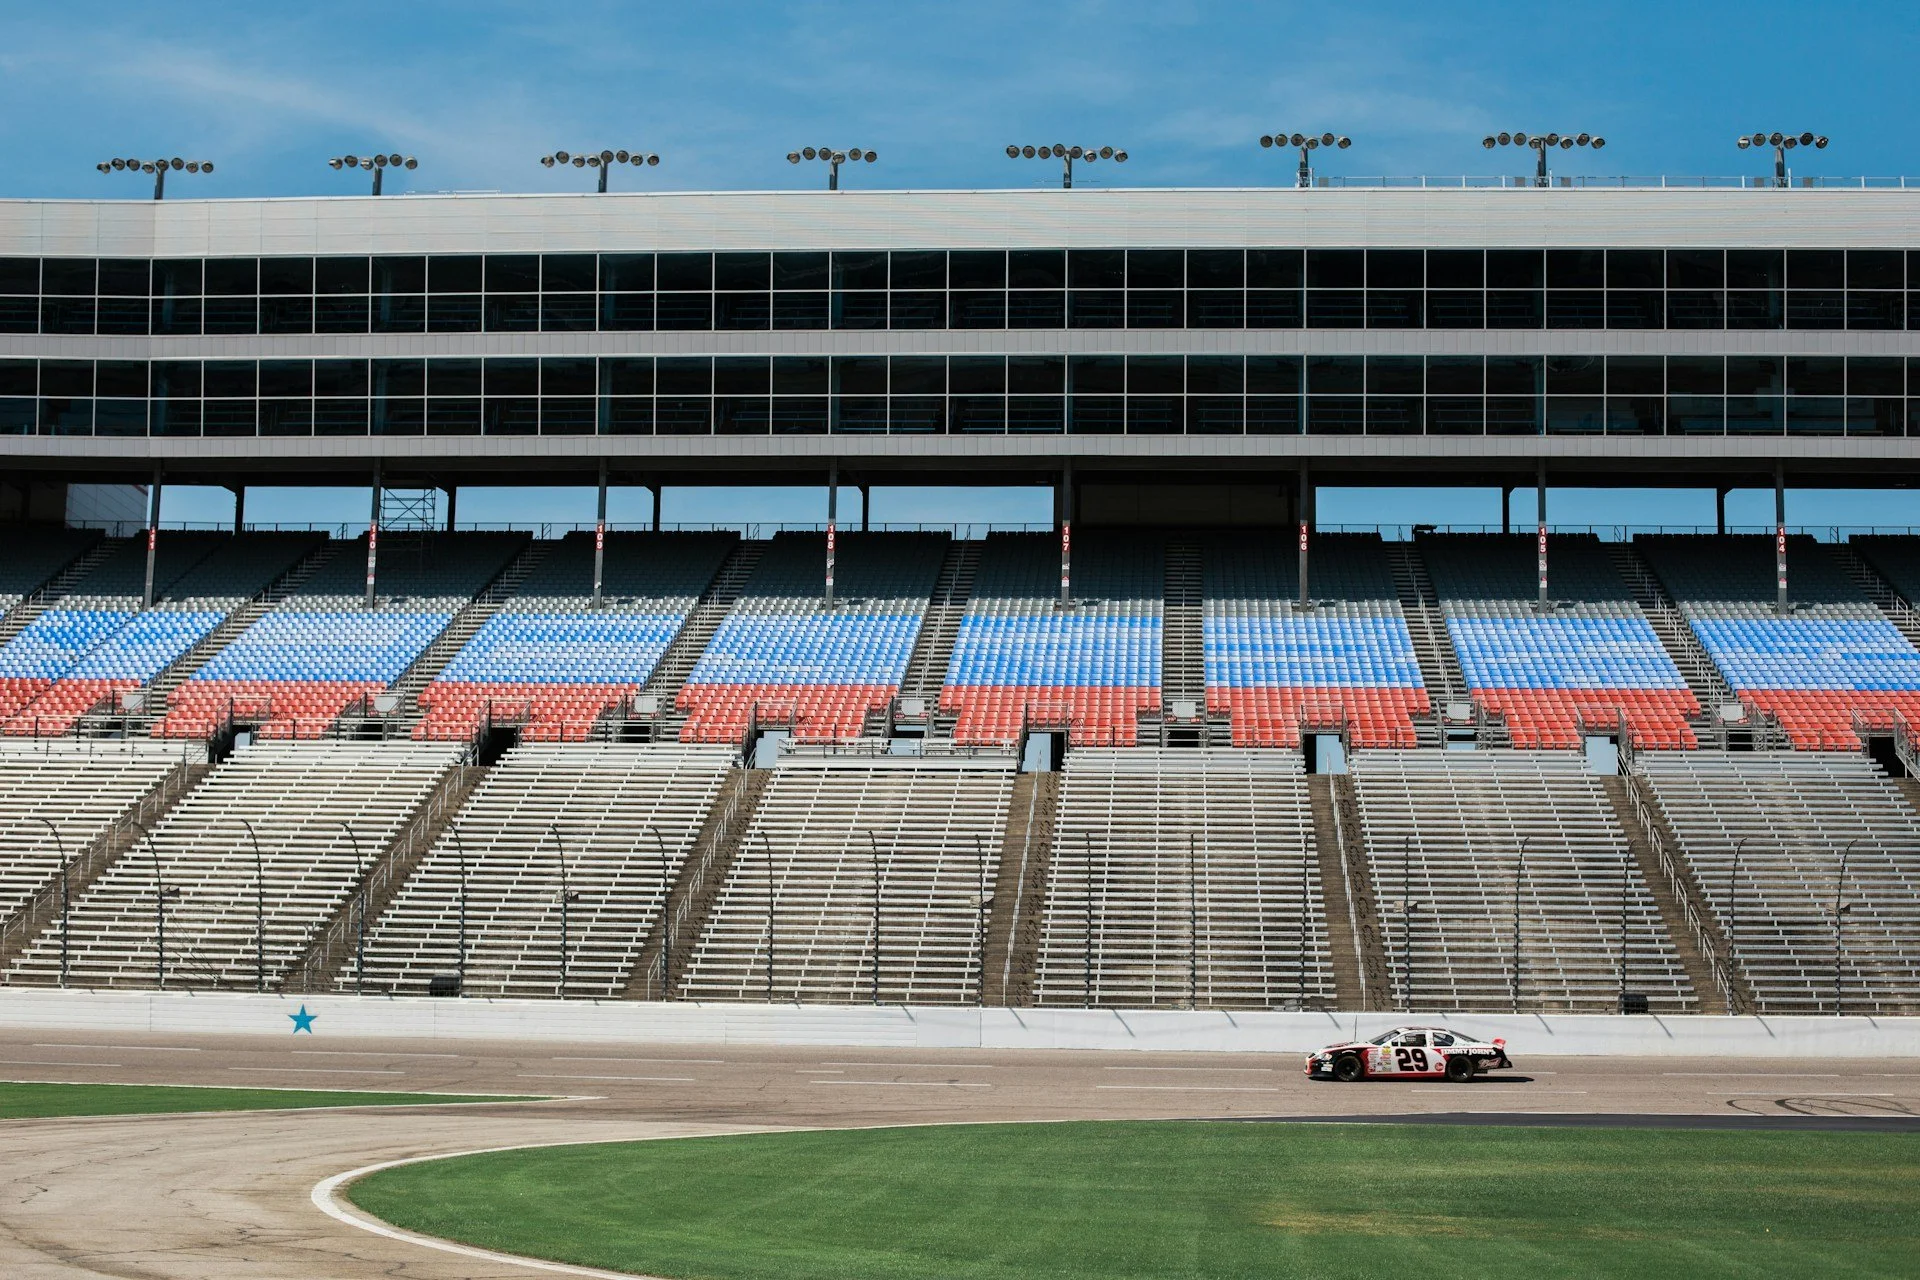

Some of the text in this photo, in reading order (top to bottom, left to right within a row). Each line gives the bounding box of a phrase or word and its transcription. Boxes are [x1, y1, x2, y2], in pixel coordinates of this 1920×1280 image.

[369, 524, 377, 550] 110
[1062, 525, 1070, 551] 107
[1778, 527, 1786, 553] 104
[1395, 1048, 1429, 1071] 29
[1440, 1048, 1496, 1056] JIMMY JOHN'S
